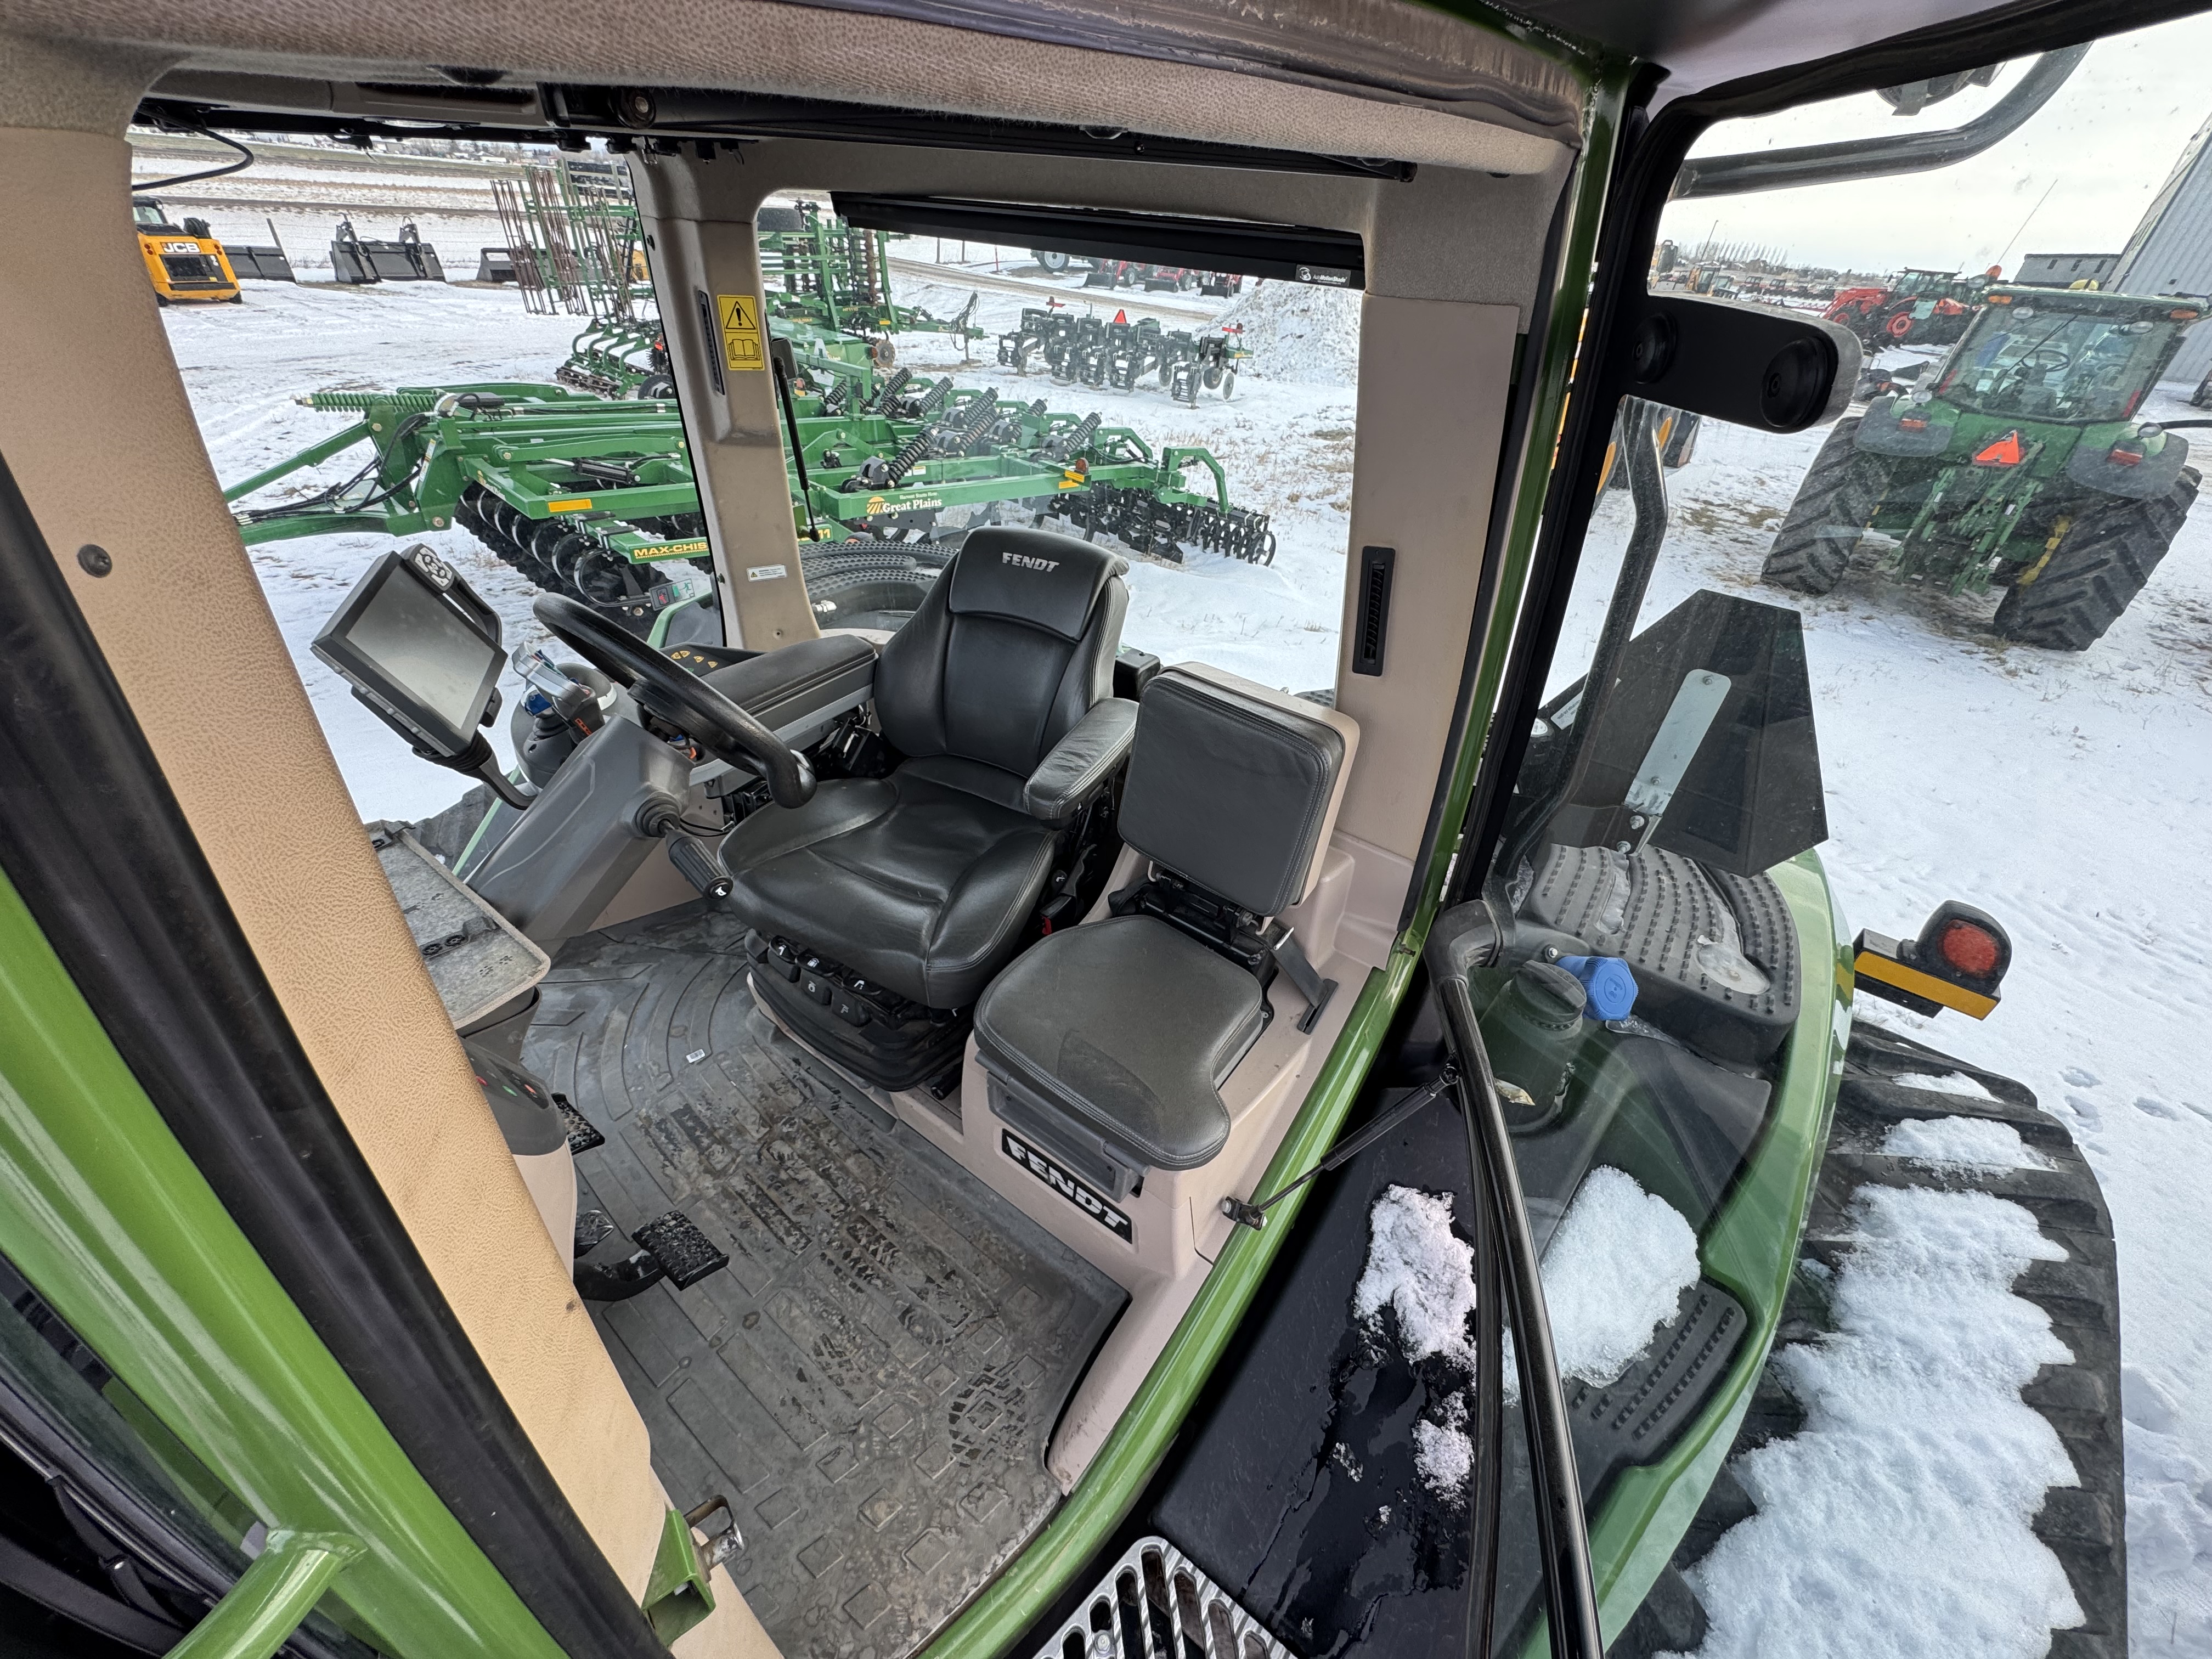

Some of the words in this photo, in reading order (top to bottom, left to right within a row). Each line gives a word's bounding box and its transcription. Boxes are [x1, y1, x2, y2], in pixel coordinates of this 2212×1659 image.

[163, 242, 200, 253] JCB
[882, 501, 911, 512] Great
[912, 498, 942, 510] Plains
[1002, 552, 1060, 572] FENDT
[1006, 1136, 1128, 1228] FENDT
